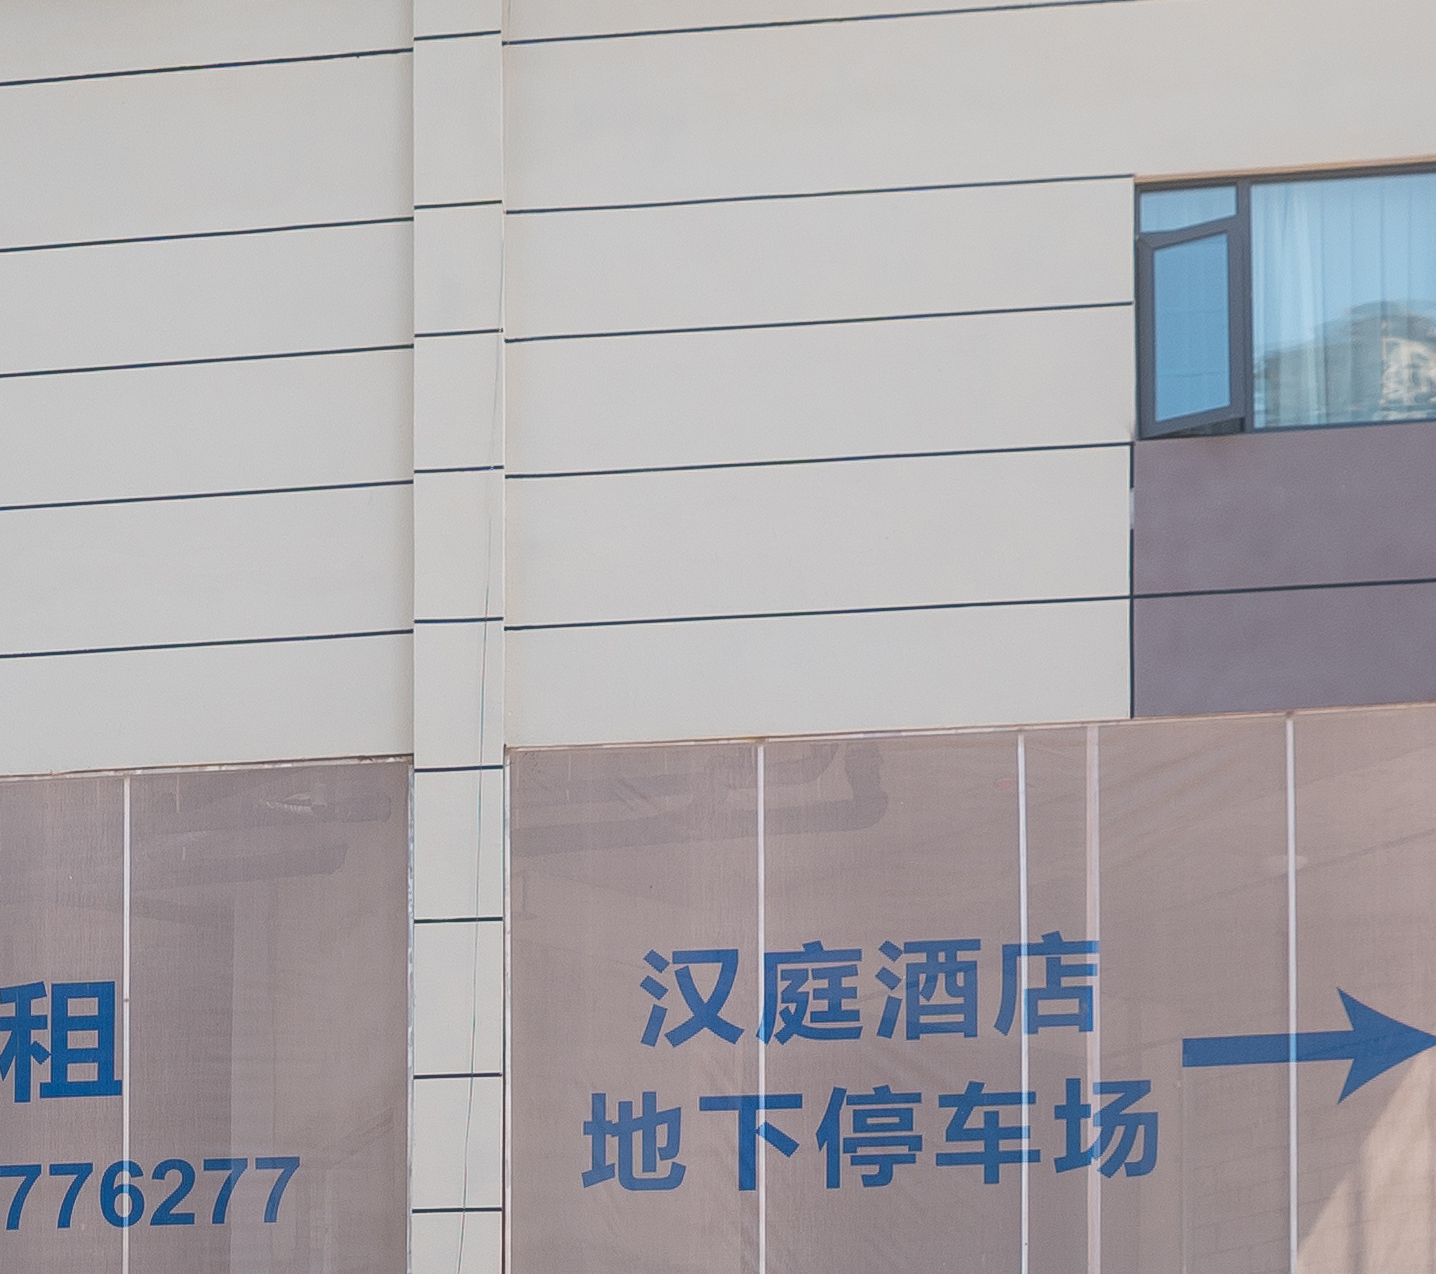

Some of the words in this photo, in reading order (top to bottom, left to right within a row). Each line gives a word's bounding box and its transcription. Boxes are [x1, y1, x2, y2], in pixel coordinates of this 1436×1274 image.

[639, 930, 1101, 1049] 汉庭酒店
[581, 1077, 1160, 1193] 地下停车场
